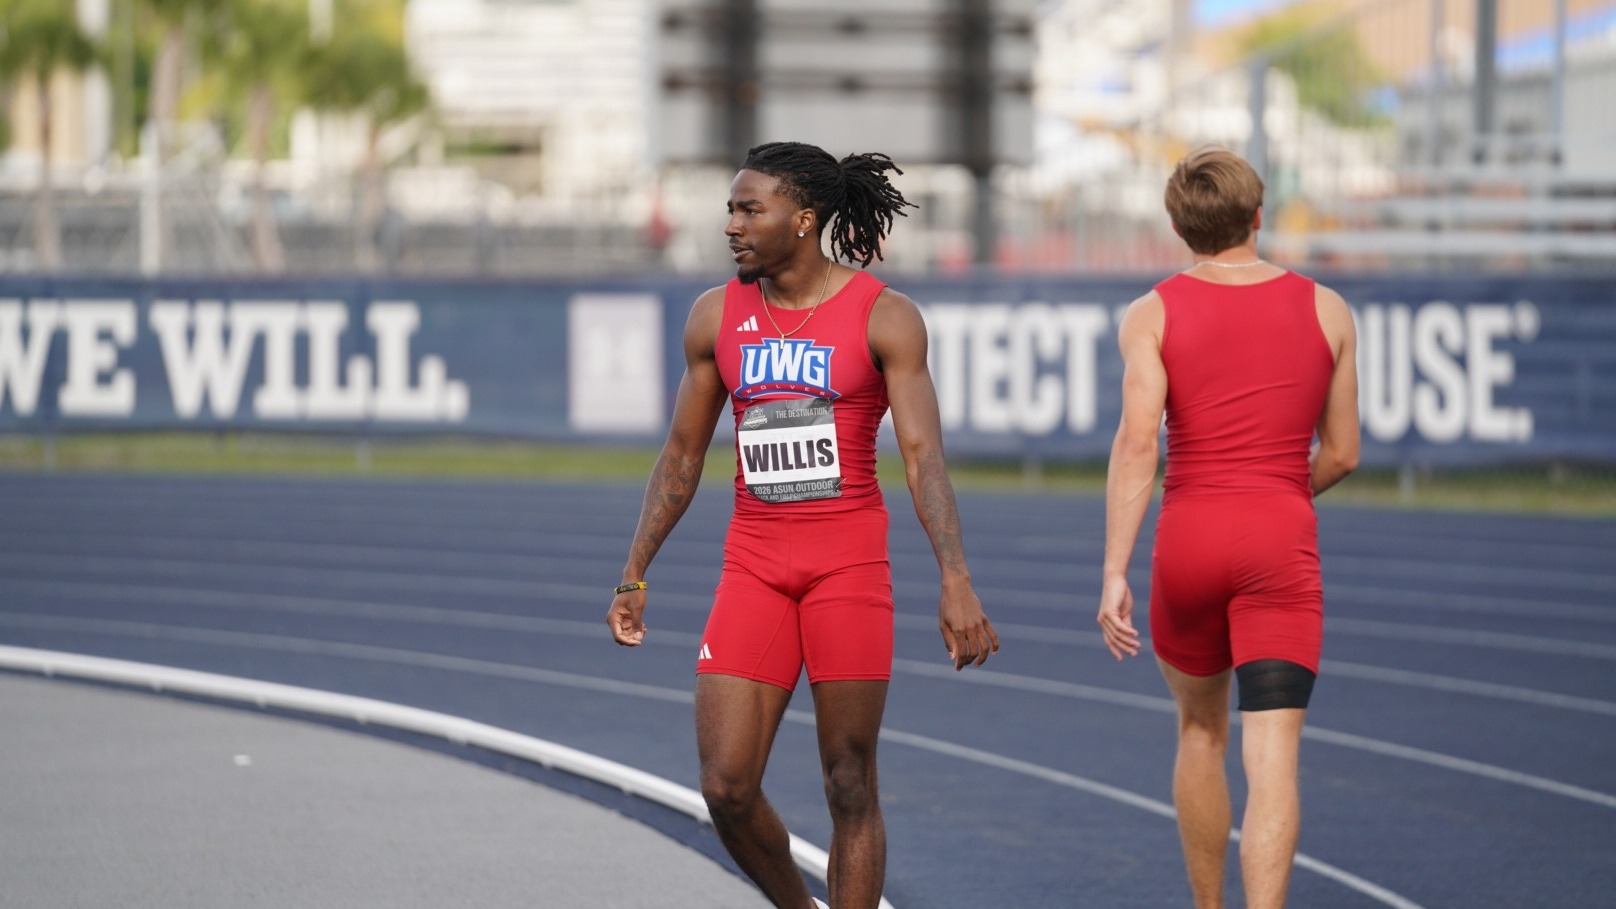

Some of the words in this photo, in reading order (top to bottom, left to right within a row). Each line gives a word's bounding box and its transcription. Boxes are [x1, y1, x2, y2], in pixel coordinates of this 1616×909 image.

[0, 300, 137, 416] WE
[151, 301, 469, 420] WILL.
[745, 342, 824, 388] UWG
[925, 303, 1110, 433] TECT
[1357, 302, 1535, 442] USE.
[745, 384, 825, 397] WOLVES
[776, 410, 787, 418] THE
[743, 438, 834, 472] WILLIS
[754, 486, 771, 495] 2026
[773, 484, 794, 494] ASUN
[796, 480, 833, 492] OUTDOOR
